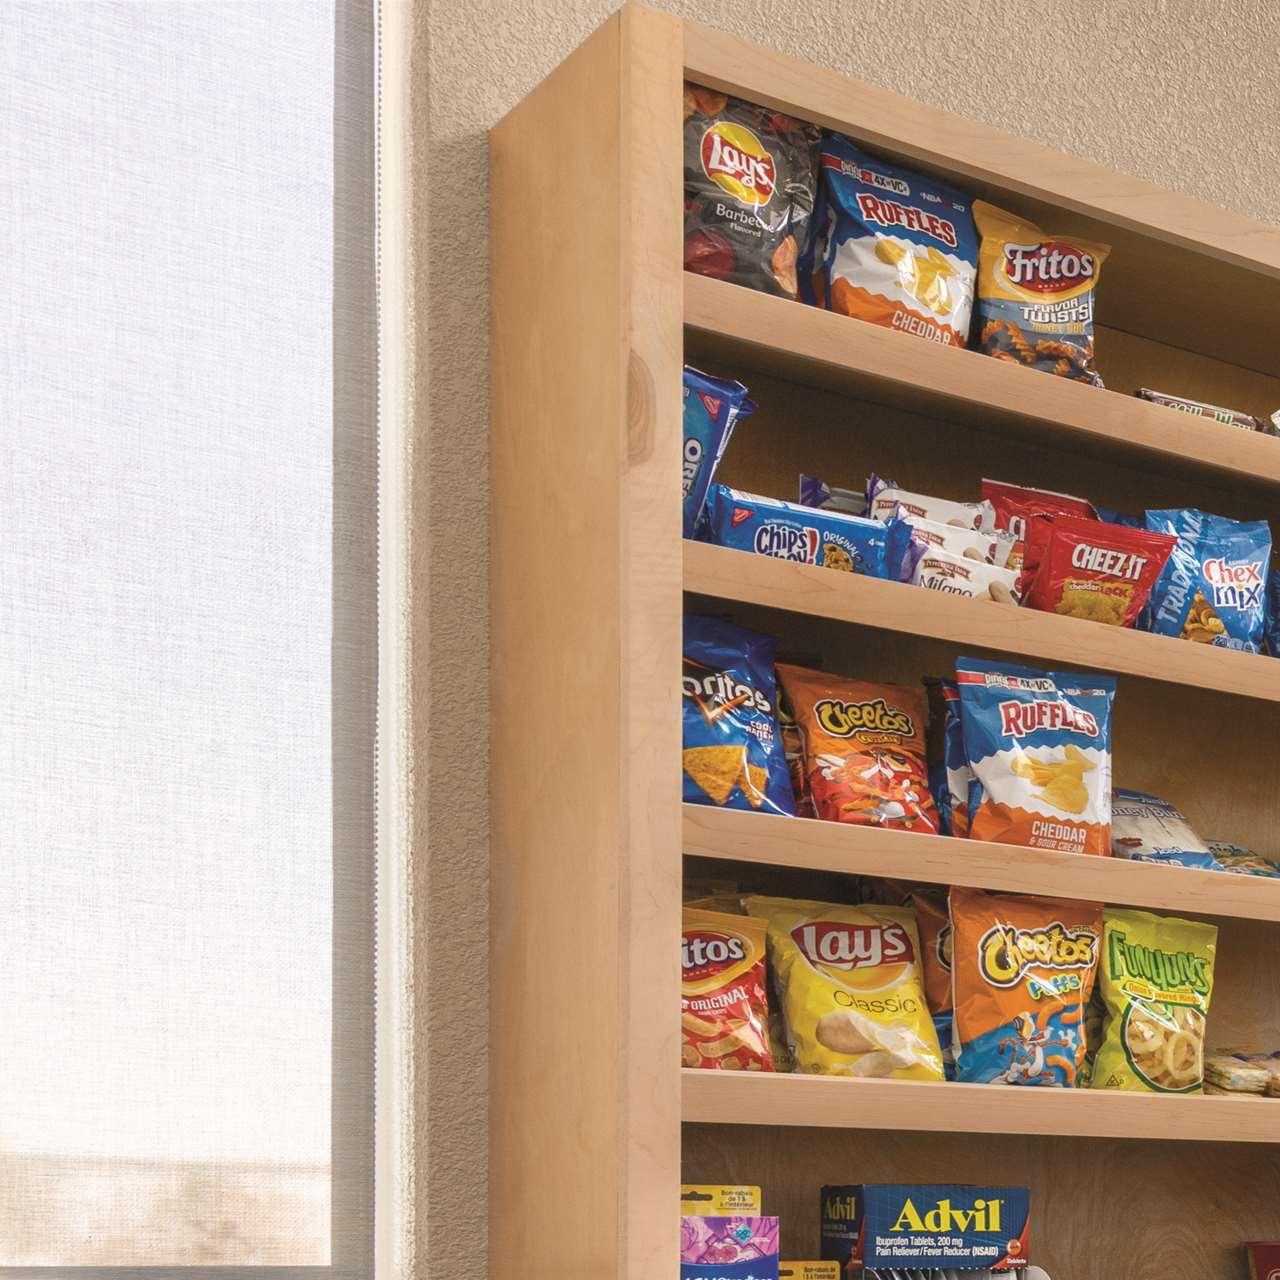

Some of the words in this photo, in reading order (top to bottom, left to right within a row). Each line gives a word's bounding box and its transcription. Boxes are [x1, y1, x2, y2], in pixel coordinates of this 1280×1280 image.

[708, 133, 772, 189] Lay's
[856, 193, 957, 247] RUFFLES
[1003, 243, 1093, 283] Fritos
[1020, 303, 1090, 323] TWISTS
[1034, 298, 1078, 313] FLAVOR
[755, 525, 809, 555] Chips
[823, 530, 860, 559] ORIGINAL
[1203, 557, 1263, 585] Chex
[1214, 582, 1262, 610] mix
[682, 672, 771, 712] oritos
[750, 720, 773, 732] COOL
[816, 700, 911, 735] Cheetos
[999, 701, 1099, 737] RUFFLES
[1112, 805, 1151, 818] oney
[1032, 820, 1087, 843] CHEDDAR
[682, 937, 744, 969] itos
[802, 924, 906, 971] Lay's
[981, 924, 1095, 985] Cheetos
[690, 985, 749, 1011] ORIGINAL
[833, 990, 918, 1013] Classic
[825, 1195, 857, 1221] Advil
[889, 1197, 1002, 1233] Advil
[875, 1236, 909, 1247] Ibuprofen
[910, 1236, 936, 1246] Tablets,
[938, 1237, 950, 1246] 200
[952, 1238, 963, 1248] mg
[875, 1246, 892, 1256] Pain
[943, 1247, 971, 1257] Reducer
[972, 1245, 999, 1257] (NSAID)
